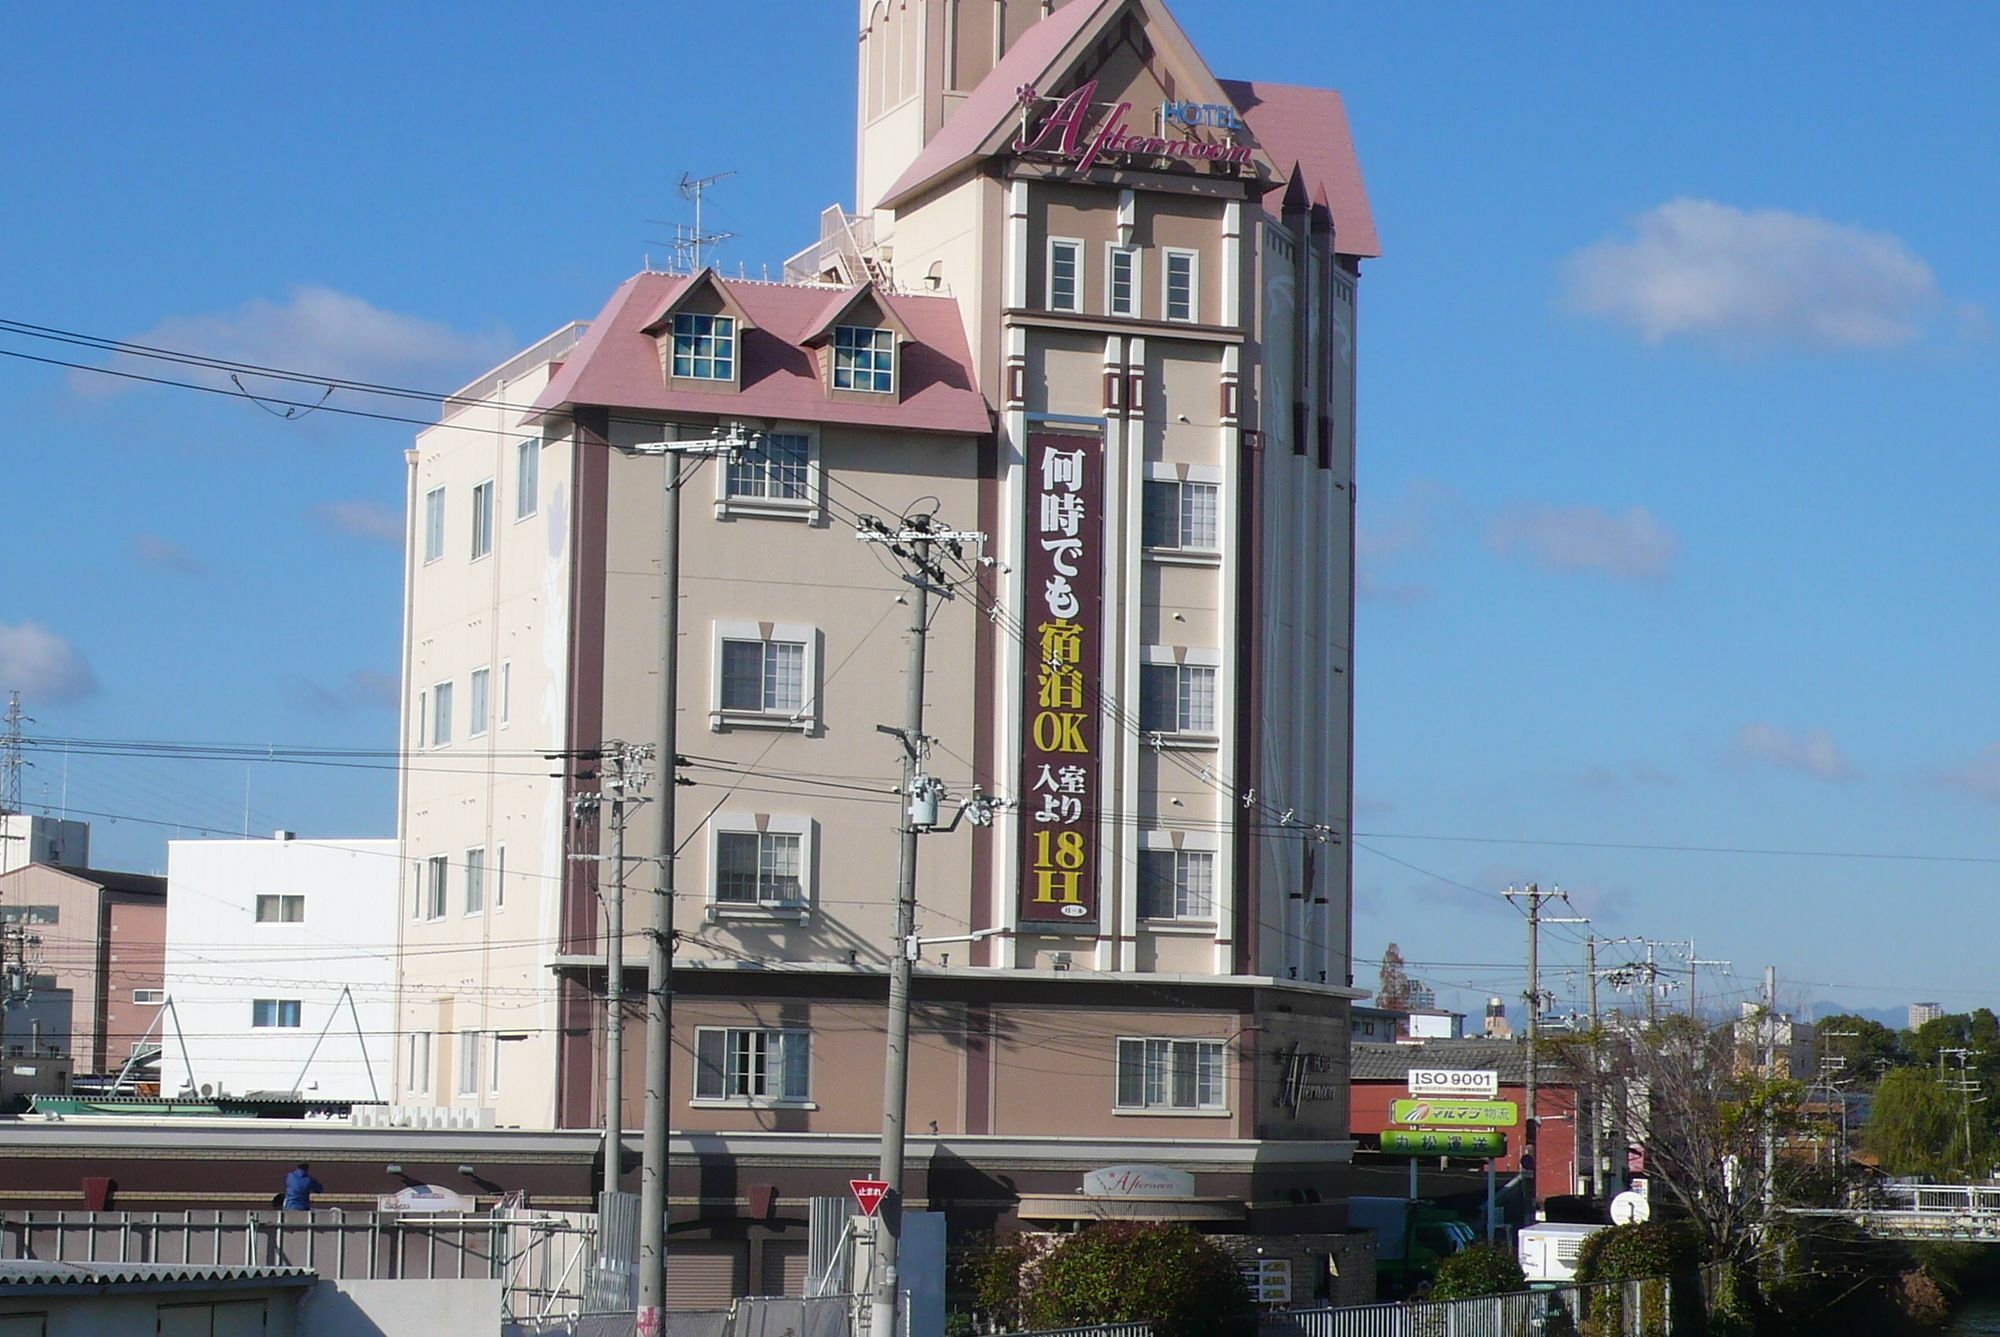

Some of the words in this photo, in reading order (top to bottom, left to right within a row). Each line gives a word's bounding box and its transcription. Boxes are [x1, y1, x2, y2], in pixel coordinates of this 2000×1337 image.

[1163, 100, 1242, 129] HOTEL
[1012, 80, 1252, 172] Afternoon
[1415, 1072, 1448, 1085] ISO
[1451, 1073, 1490, 1086] 9001
[858, 1187, 881, 1197] 止まれ
